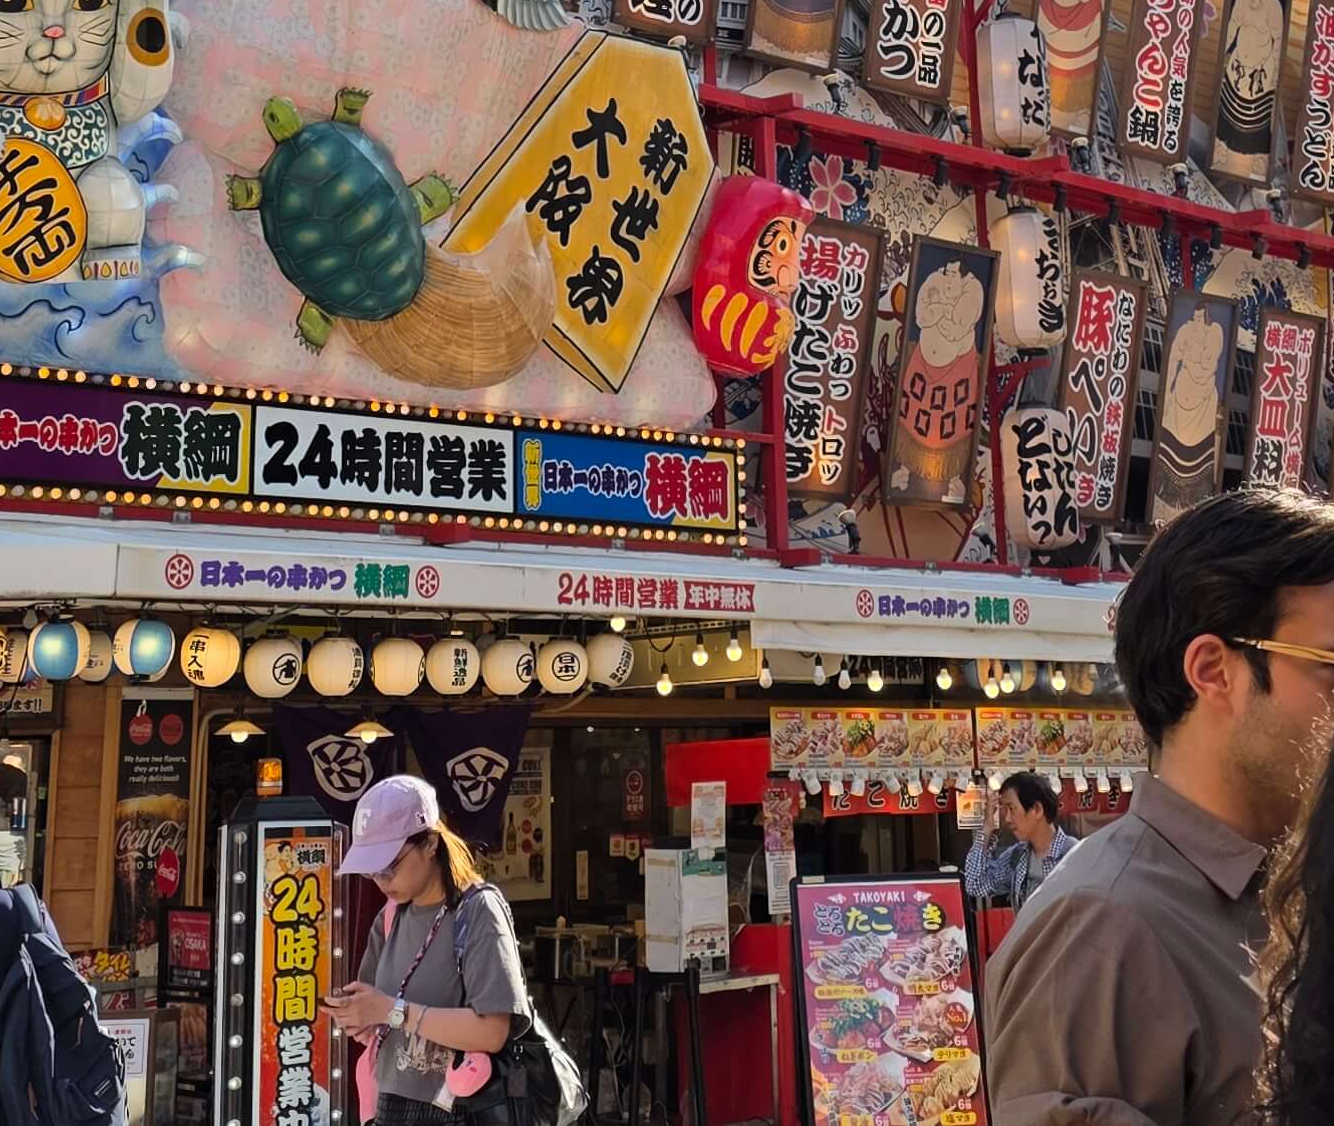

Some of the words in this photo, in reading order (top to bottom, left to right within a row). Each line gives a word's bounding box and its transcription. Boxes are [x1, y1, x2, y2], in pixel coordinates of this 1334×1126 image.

[565, 117, 690, 326] 新世界
[784, 235, 845, 483] 揚げたこ焼き
[820, 245, 868, 485] カリッふわっトロッ
[1096, 292, 1135, 511] なにわの鉄板焼き
[119, 401, 243, 486] 横綱
[1253, 352, 1294, 486] 大皿料
[1285, 328, 1316, 486] ボリューム横
[265, 420, 513, 505] 24時間営業
[543, 462, 644, 501] 日本一の串かつ
[644, 455, 733, 520] 横綱
[199, 560, 347, 590] 日本一の串かつ
[355, 564, 410, 600] 横綱
[558, 572, 679, 610] 24時間営業
[686, 582, 754, 612] 年中無休
[878, 596, 970, 619] 日本一の串かつ
[975, 596, 1010, 626] 横綱
[187, 635, 209, 681] 一串入魂
[846, 903, 943, 933] たこ焼き
[853, 891, 906, 903] TAKOYAKI
